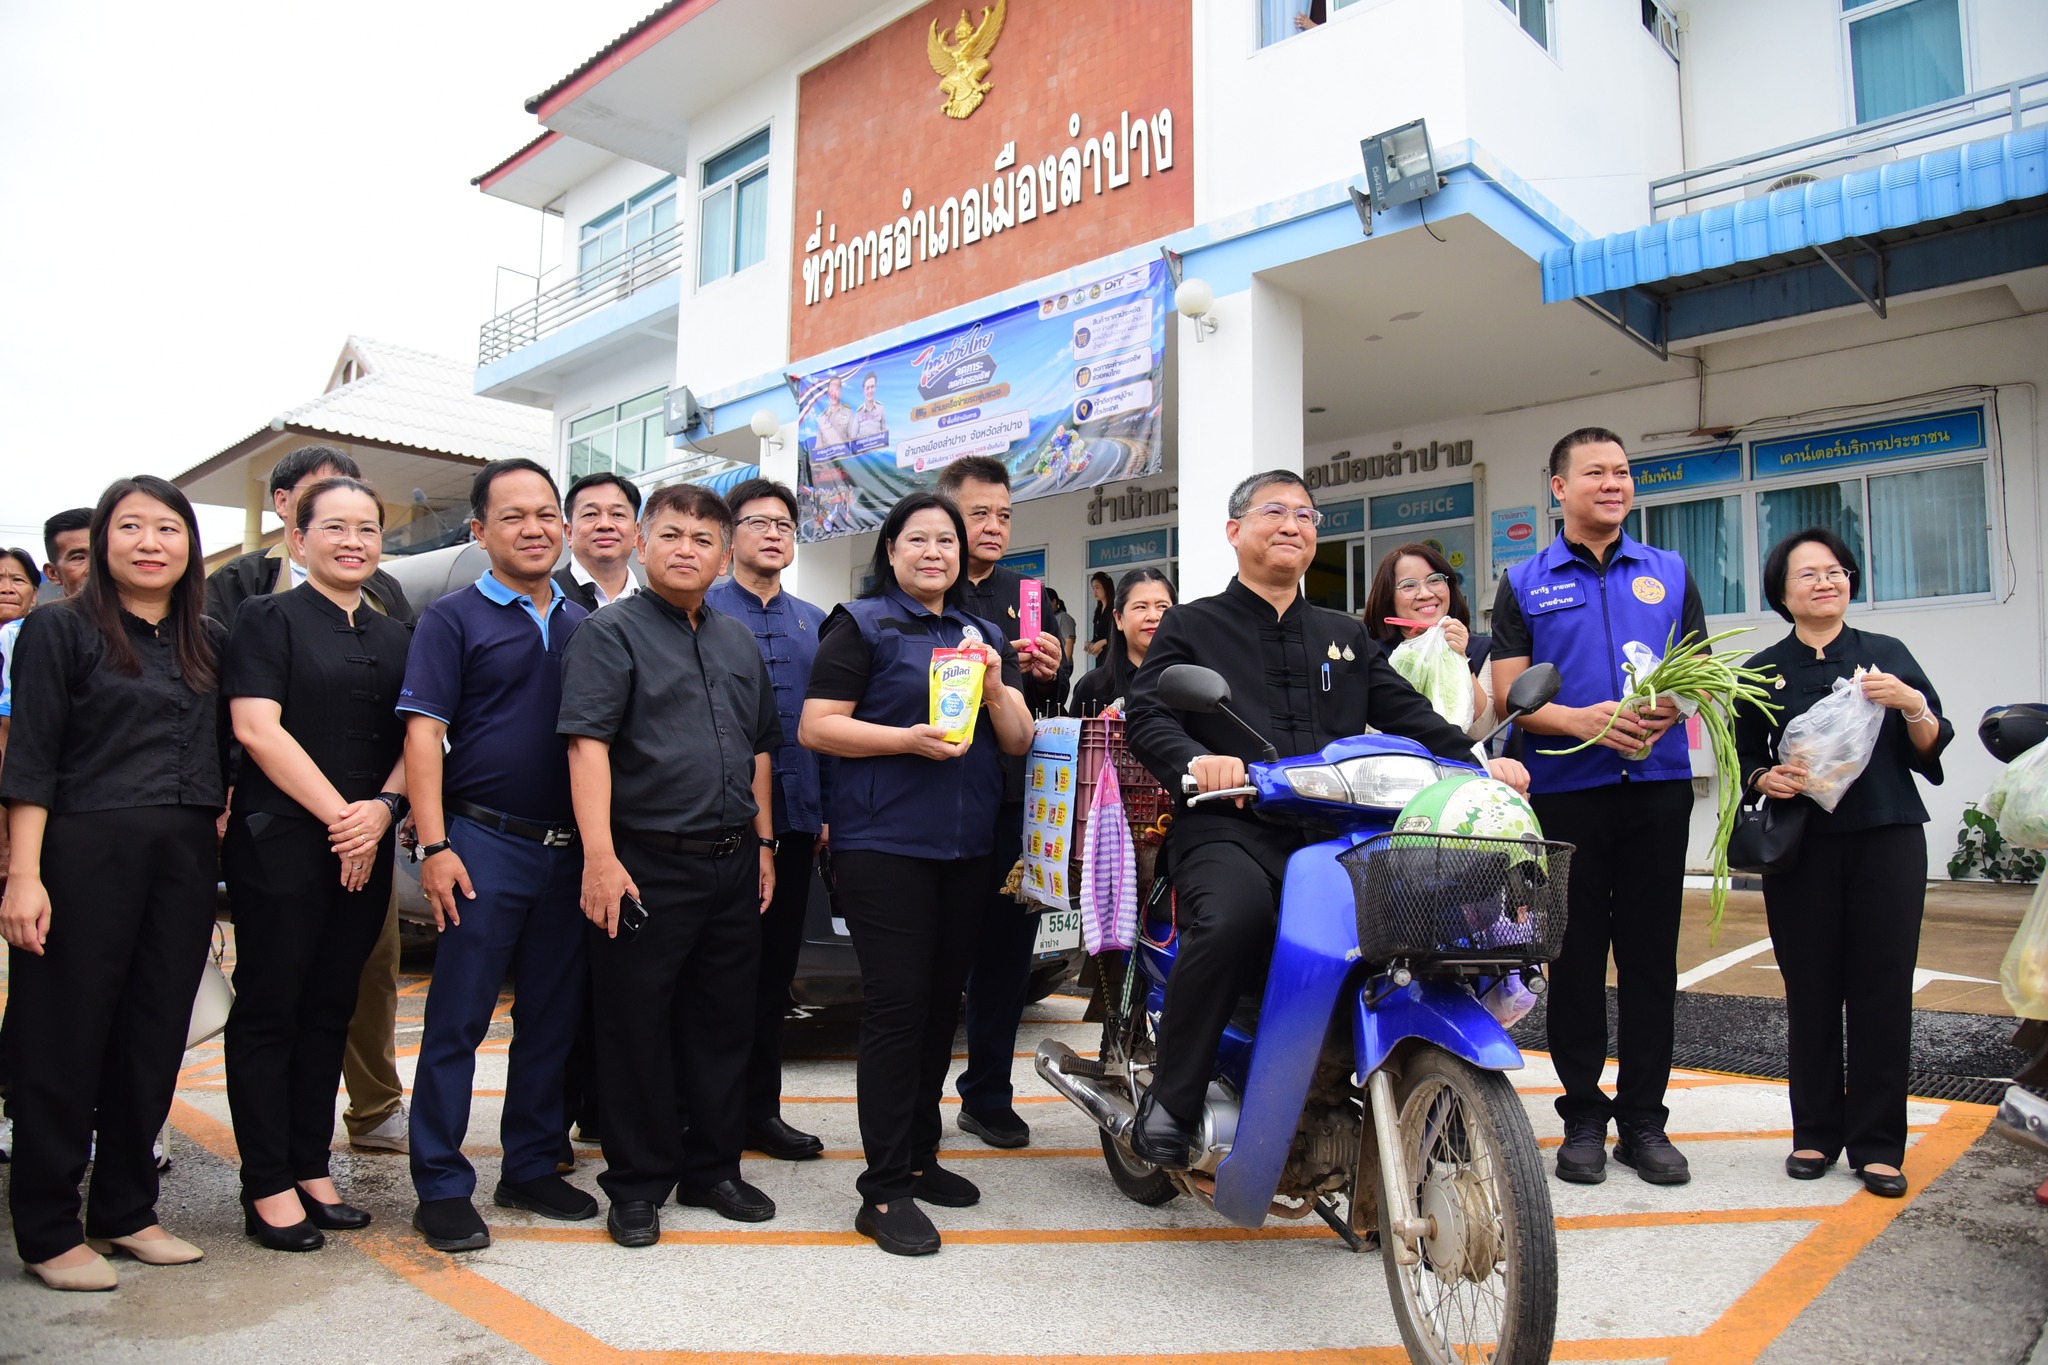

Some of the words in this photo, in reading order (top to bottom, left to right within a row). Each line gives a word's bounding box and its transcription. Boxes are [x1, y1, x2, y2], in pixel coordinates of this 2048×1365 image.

[802, 107, 1174, 307] ที่ว่าการอำเภอเมืองลำปาง
[955, 361, 984, 376] ลดภาระ
[904, 433, 967, 457] อำเภอเมืองลำปาง
[970, 420, 1023, 441] จังหวัดลำปาง
[1779, 430, 1951, 466] เคาน์เตอร์บริการประชาชน
[1631, 463, 1684, 486] าสัมพันธ์
[1101, 541, 1158, 561] MUEANG
[1397, 497, 1455, 519] OFFICE
[1048, 912, 1079, 933] 5542
[1040, 937, 1059, 949] ลำปาง
